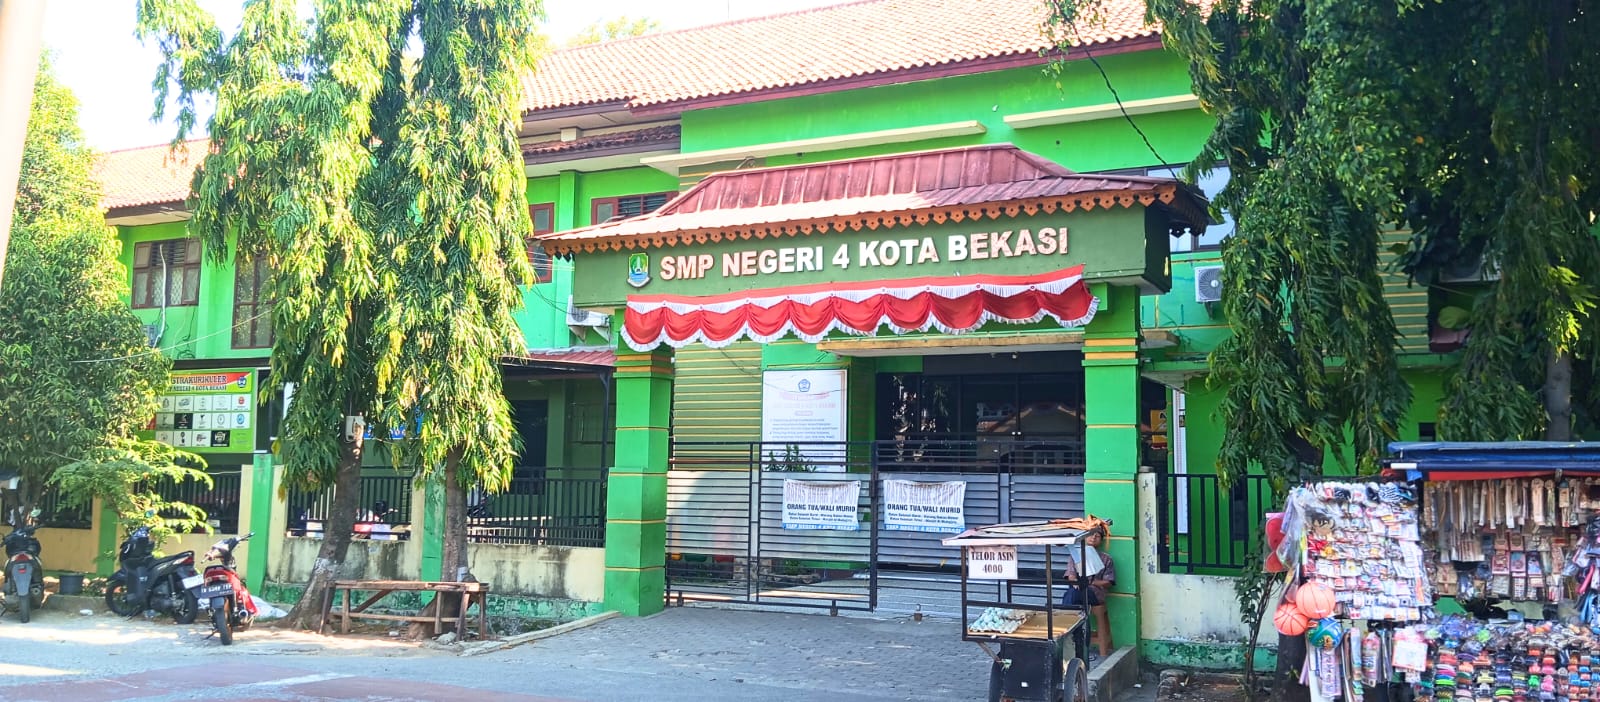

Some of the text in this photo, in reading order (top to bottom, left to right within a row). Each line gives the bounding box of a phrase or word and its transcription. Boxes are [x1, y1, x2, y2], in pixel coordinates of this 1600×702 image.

[660, 227, 1068, 281] SMP NEGERI 4 KOTA BEKASI
[808, 504, 835, 512] TUA/WALI
[836, 505, 856, 513] MURID
[887, 503, 961, 514] ORANG TUA/WALI MURID
[971, 551, 1014, 561] TELOR ASIN
[982, 564, 1003, 574] 4000
